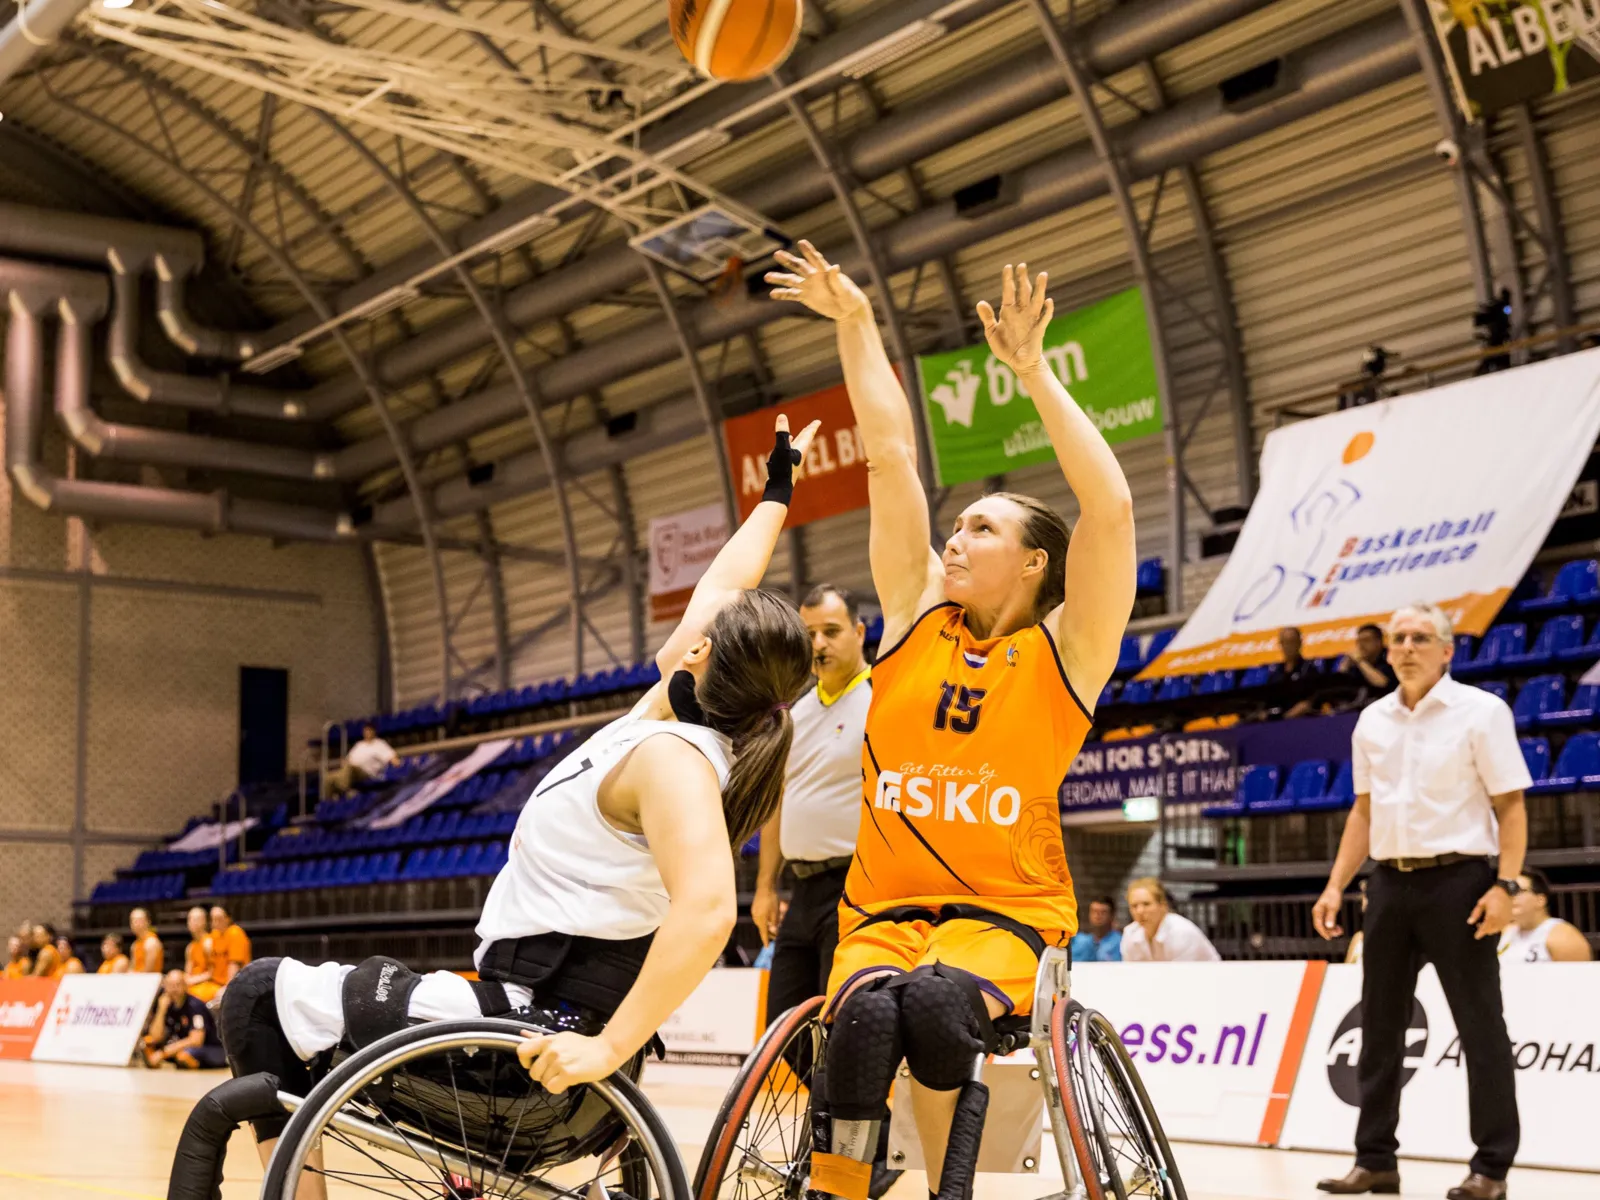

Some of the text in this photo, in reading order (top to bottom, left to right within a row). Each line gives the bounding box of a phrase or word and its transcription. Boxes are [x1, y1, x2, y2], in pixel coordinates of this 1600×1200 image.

[985, 341, 1089, 406] bm
[1339, 510, 1495, 558] Basketball
[1324, 542, 1478, 583] Experience
[932, 679, 988, 735] 15
[899, 762, 998, 785] Get Fitter by
[1068, 752, 1103, 776] ON
[1107, 746, 1144, 773] FOR
[1120, 1013, 1268, 1066] ess.nl
